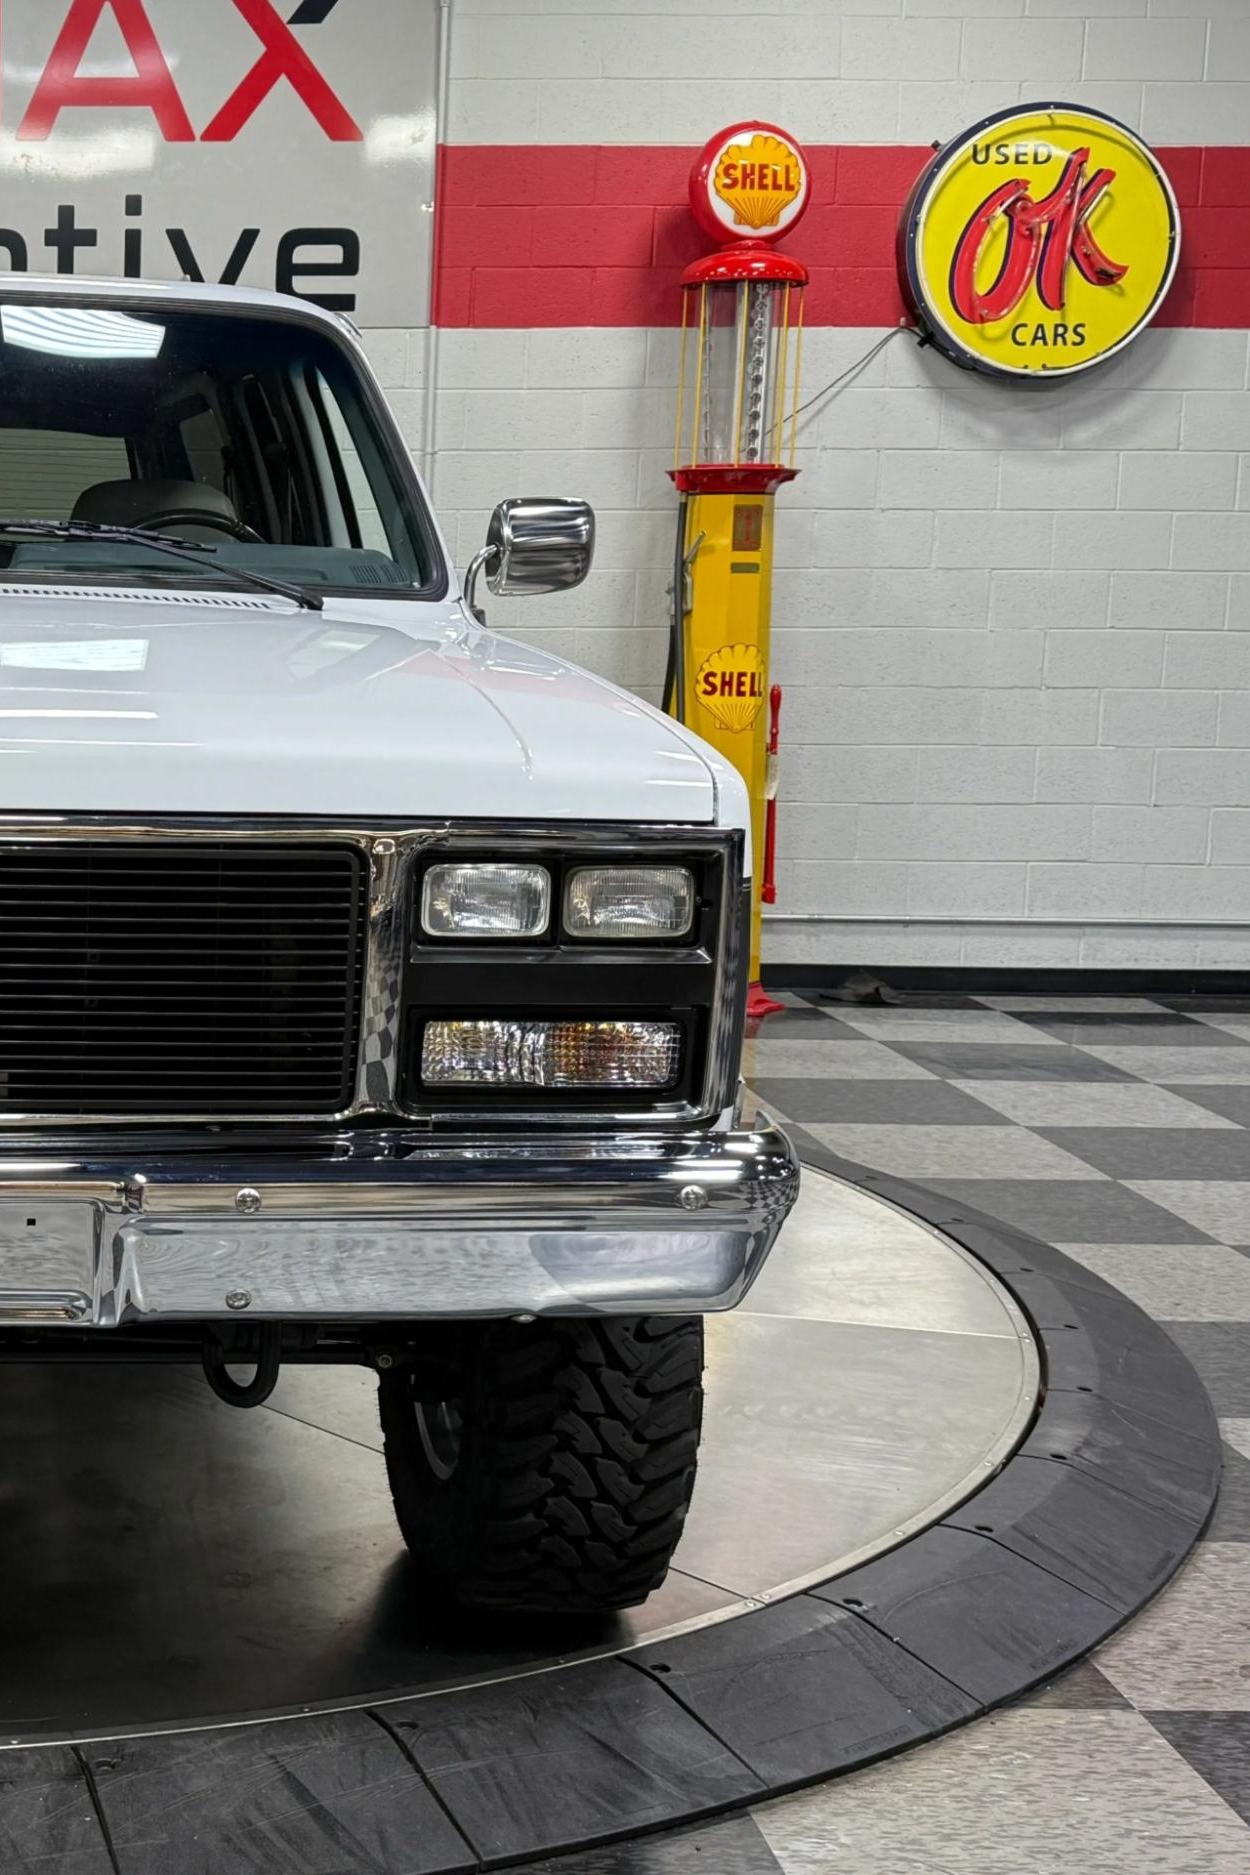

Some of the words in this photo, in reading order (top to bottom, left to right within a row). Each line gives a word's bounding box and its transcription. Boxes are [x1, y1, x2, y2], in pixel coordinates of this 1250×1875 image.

[971, 143, 1053, 165] USED
[721, 163, 795, 192] SHELL
[1011, 322, 1086, 347] CARS
[701, 670, 763, 698] SHELL
